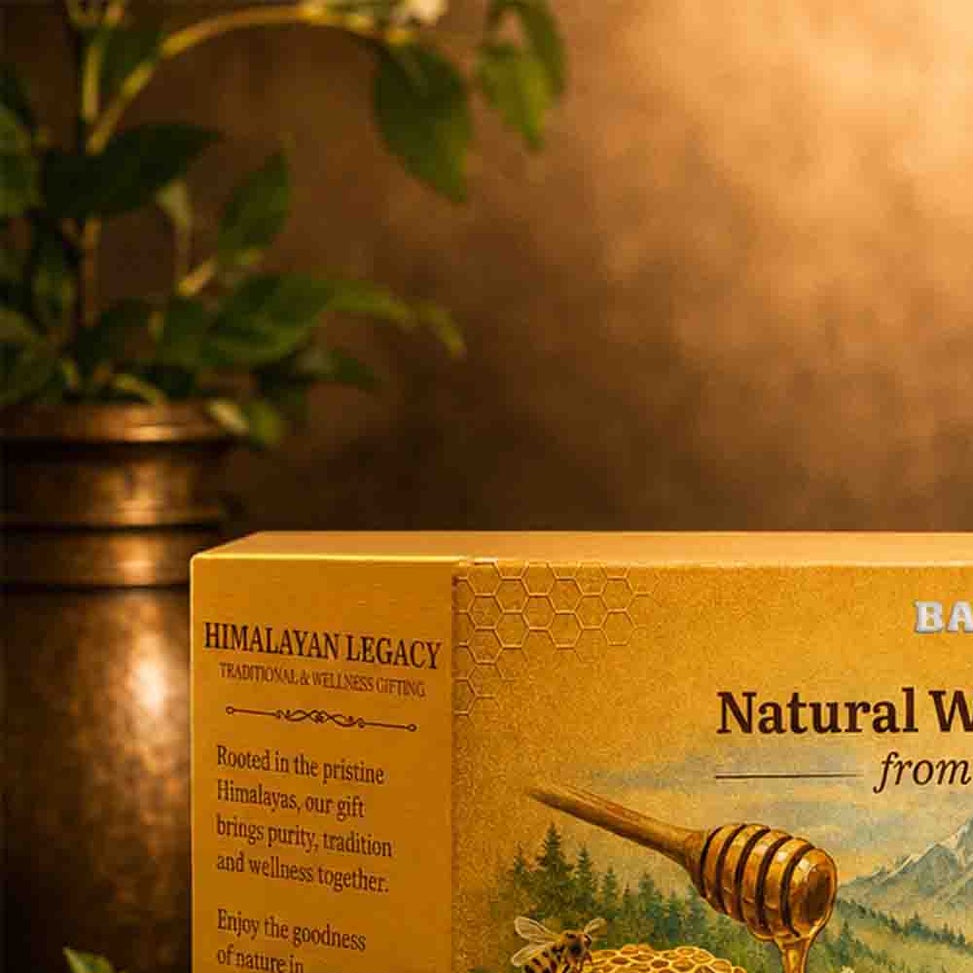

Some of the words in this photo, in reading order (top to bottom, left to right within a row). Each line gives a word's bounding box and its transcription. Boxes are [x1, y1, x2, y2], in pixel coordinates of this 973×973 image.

[204, 622, 340, 660] HIMALAYAN
[347, 635, 443, 669] LEGACY
[219, 662, 298, 685] TRADITIONAL
[300, 671, 309, 686] &
[312, 672, 375, 693] WELLNESS
[376, 677, 425, 697] GIFTING
[716, 687, 917, 735] Natural
[217, 745, 270, 772] Rooted
[274, 752, 289, 775] in
[294, 753, 318, 778] the
[322, 760, 384, 785] pristine
[873, 751, 973, 794] from
[217, 778, 301, 813] Himalayas,
[305, 794, 332, 815] our
[336, 797, 366, 822] gift
[217, 815, 264, 844] brings
[267, 824, 318, 853] purity,
[323, 829, 392, 858] tradition
[217, 853, 245, 874] and
[249, 857, 314, 883] wellness
[318, 867, 390, 894] together.
[217, 909, 259, 940] Enjoy
[264, 917, 289, 940] the
[293, 922, 366, 951] goodness
[217, 943, 234, 966] of
[236, 951, 286, 973] nature
